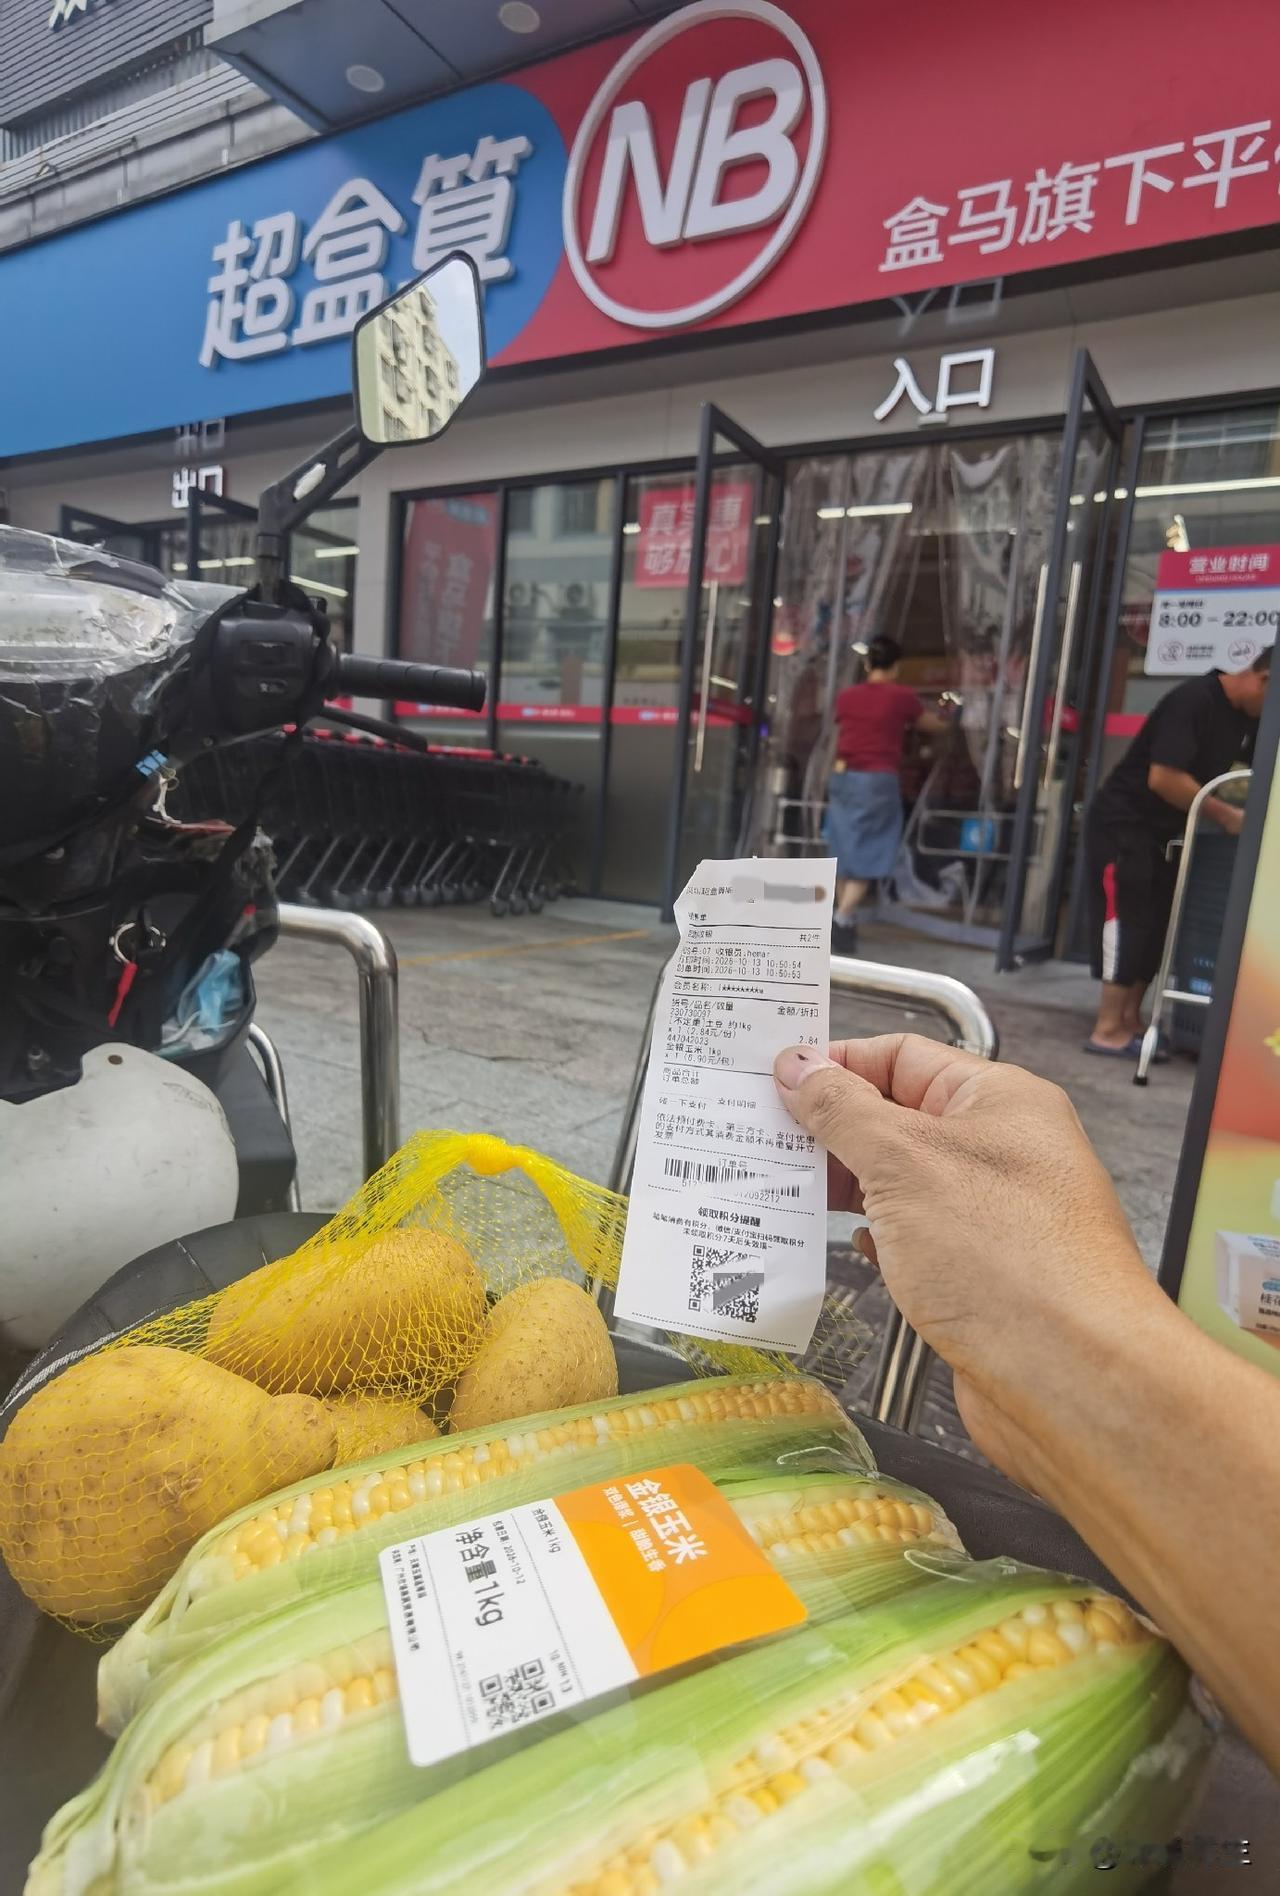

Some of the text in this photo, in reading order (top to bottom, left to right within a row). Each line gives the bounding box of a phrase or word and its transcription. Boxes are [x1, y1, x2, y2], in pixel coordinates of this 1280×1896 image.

[586, 58, 803, 264] NB
[879, 119, 1280, 273] 盒马旗下平
[873, 348, 995, 420] 入口
[1189, 553, 1270, 574] 营业时间
[777, 1005, 819, 1018] 金额/折扣
[799, 1035, 818, 1045] 2.84
[697, 1206, 761, 1228] 领取积分提醒
[624, 1478, 708, 1565] 金银玉米
[455, 1527, 505, 1627] 净含量1kg
